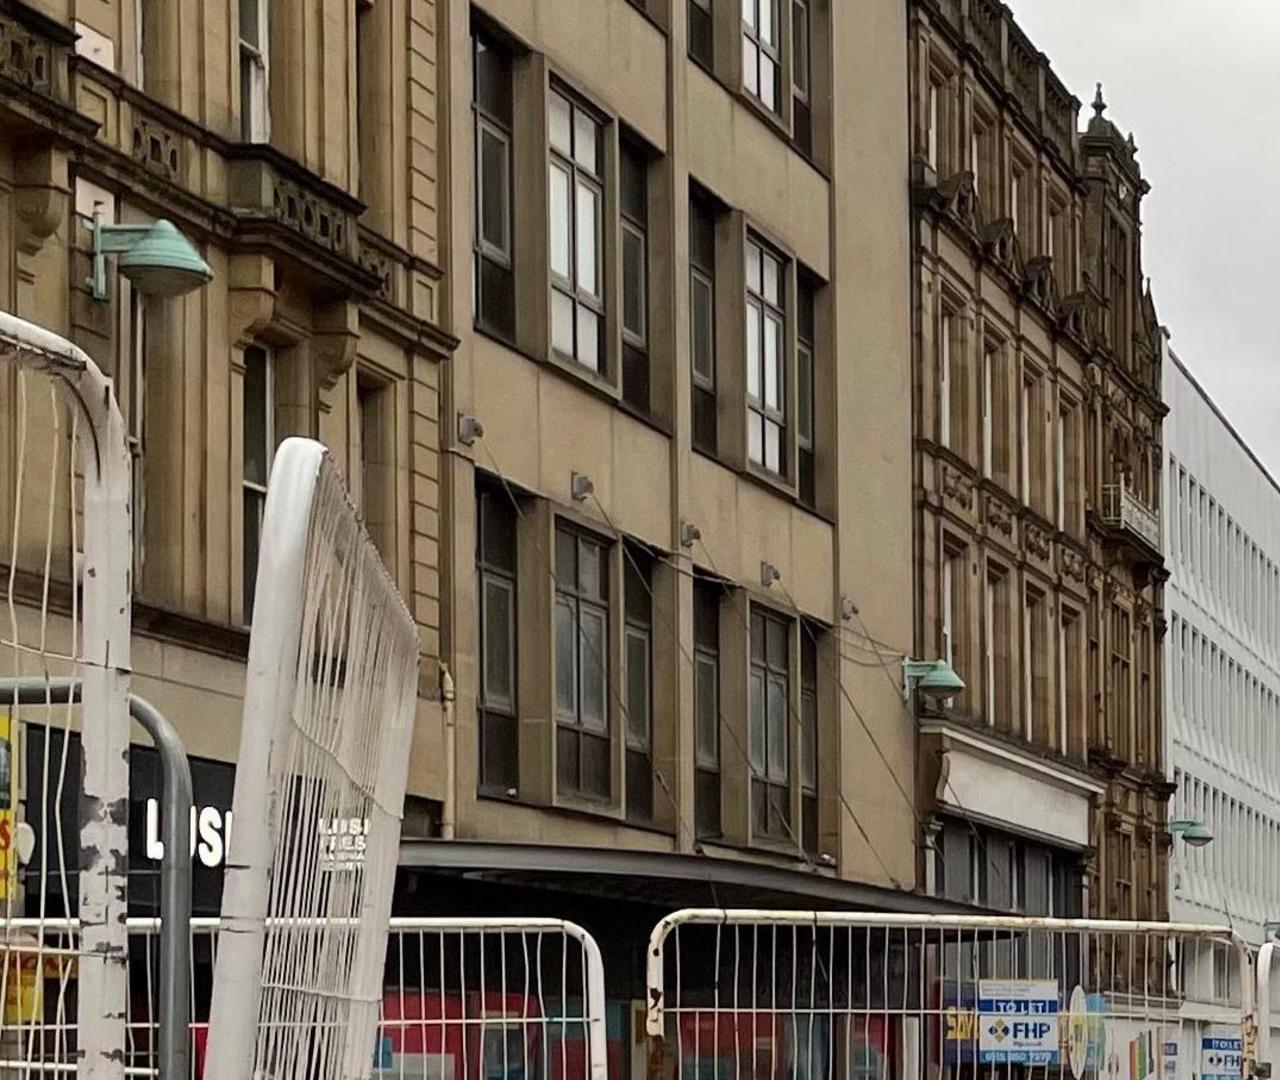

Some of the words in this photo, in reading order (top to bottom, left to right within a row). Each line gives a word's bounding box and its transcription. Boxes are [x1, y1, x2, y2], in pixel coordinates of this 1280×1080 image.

[998, 1002, 1017, 1014] TO
[1020, 1002, 1044, 1015] LET
[1012, 1022, 1051, 1040] FHP
